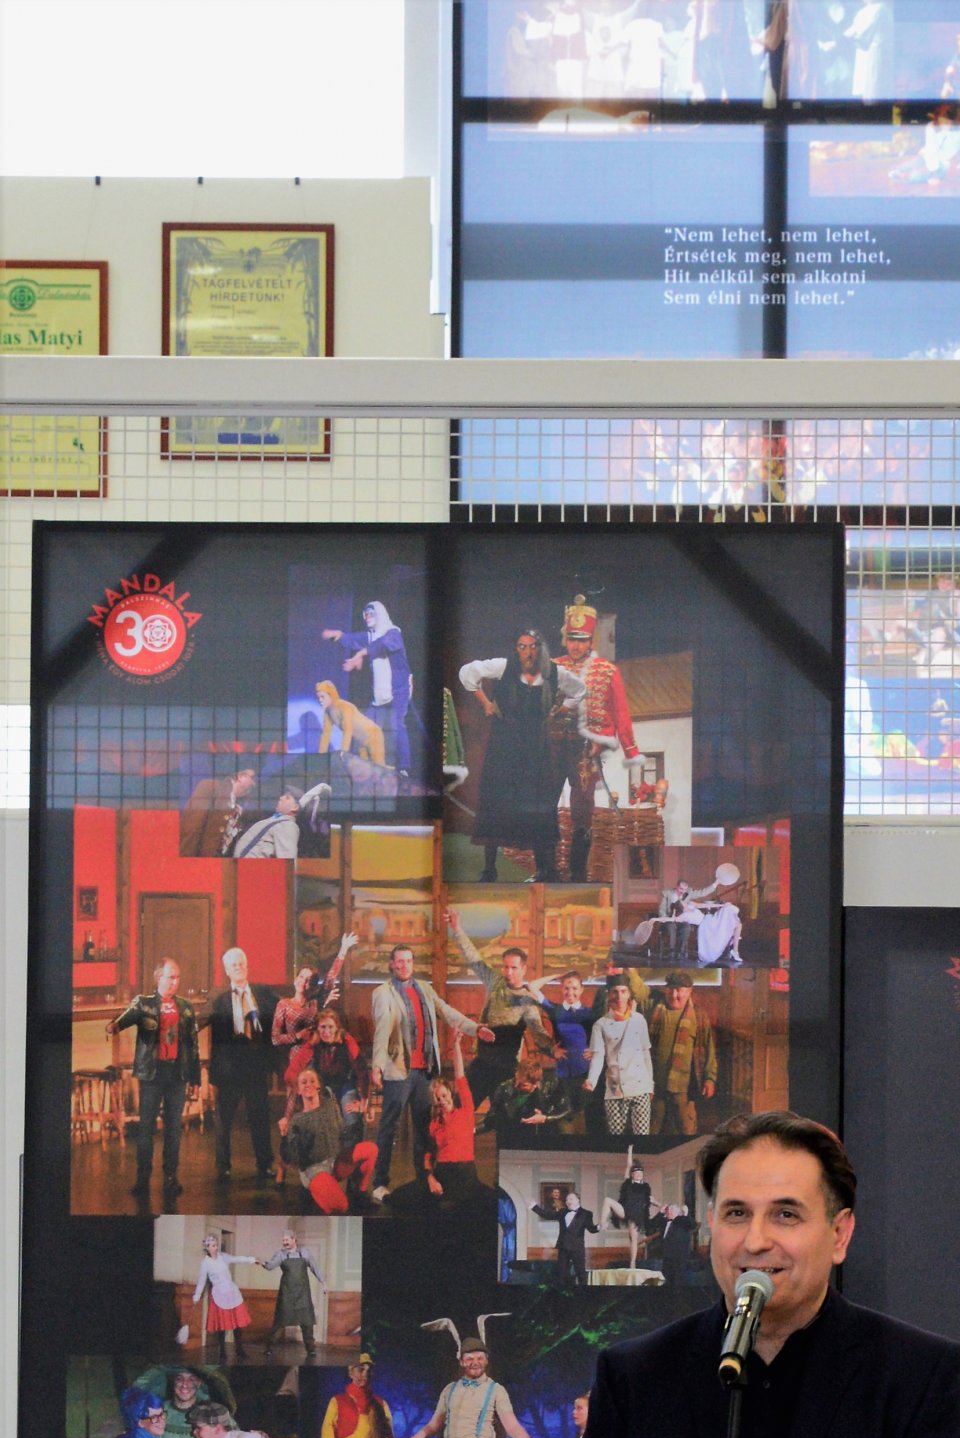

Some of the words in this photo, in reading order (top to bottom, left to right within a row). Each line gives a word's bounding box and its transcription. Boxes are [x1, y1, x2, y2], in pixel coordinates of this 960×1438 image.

[722, 228, 773, 244] lehet,
[780, 230, 818, 243] nem
[826, 228, 877, 244] lehet,
[664, 245, 738, 264] Értsétek
[745, 251, 787, 266] meg,
[795, 251, 833, 264] nem
[840, 249, 892, 266] lehet,
[664, 269, 691, 284] Hit
[761, 272, 796, 284] sem
[803, 269, 866, 284] alkotni
[663, 291, 701, 305] Sem
[708, 290, 742, 305] élni
[750, 292, 787, 305] nem
[29, 329, 82, 350] Matyi
[87, 573, 203, 629] MANDALA
